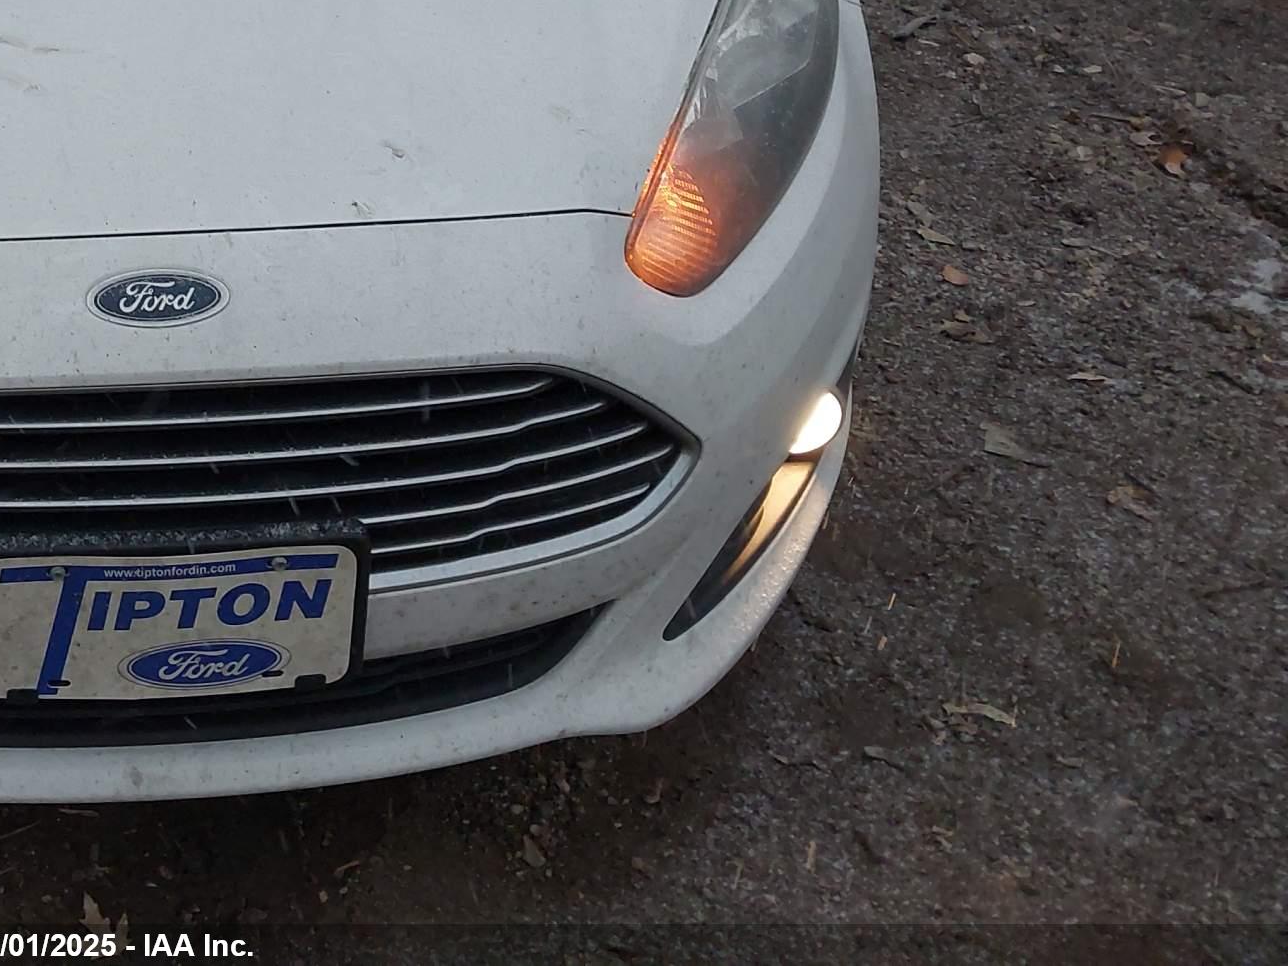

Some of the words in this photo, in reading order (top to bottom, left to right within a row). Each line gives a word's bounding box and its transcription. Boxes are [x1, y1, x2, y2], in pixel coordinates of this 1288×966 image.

[119, 281, 195, 313] Ford
[103, 562, 237, 579] www.tiptonfordin.com
[158, 648, 252, 681] Ford
